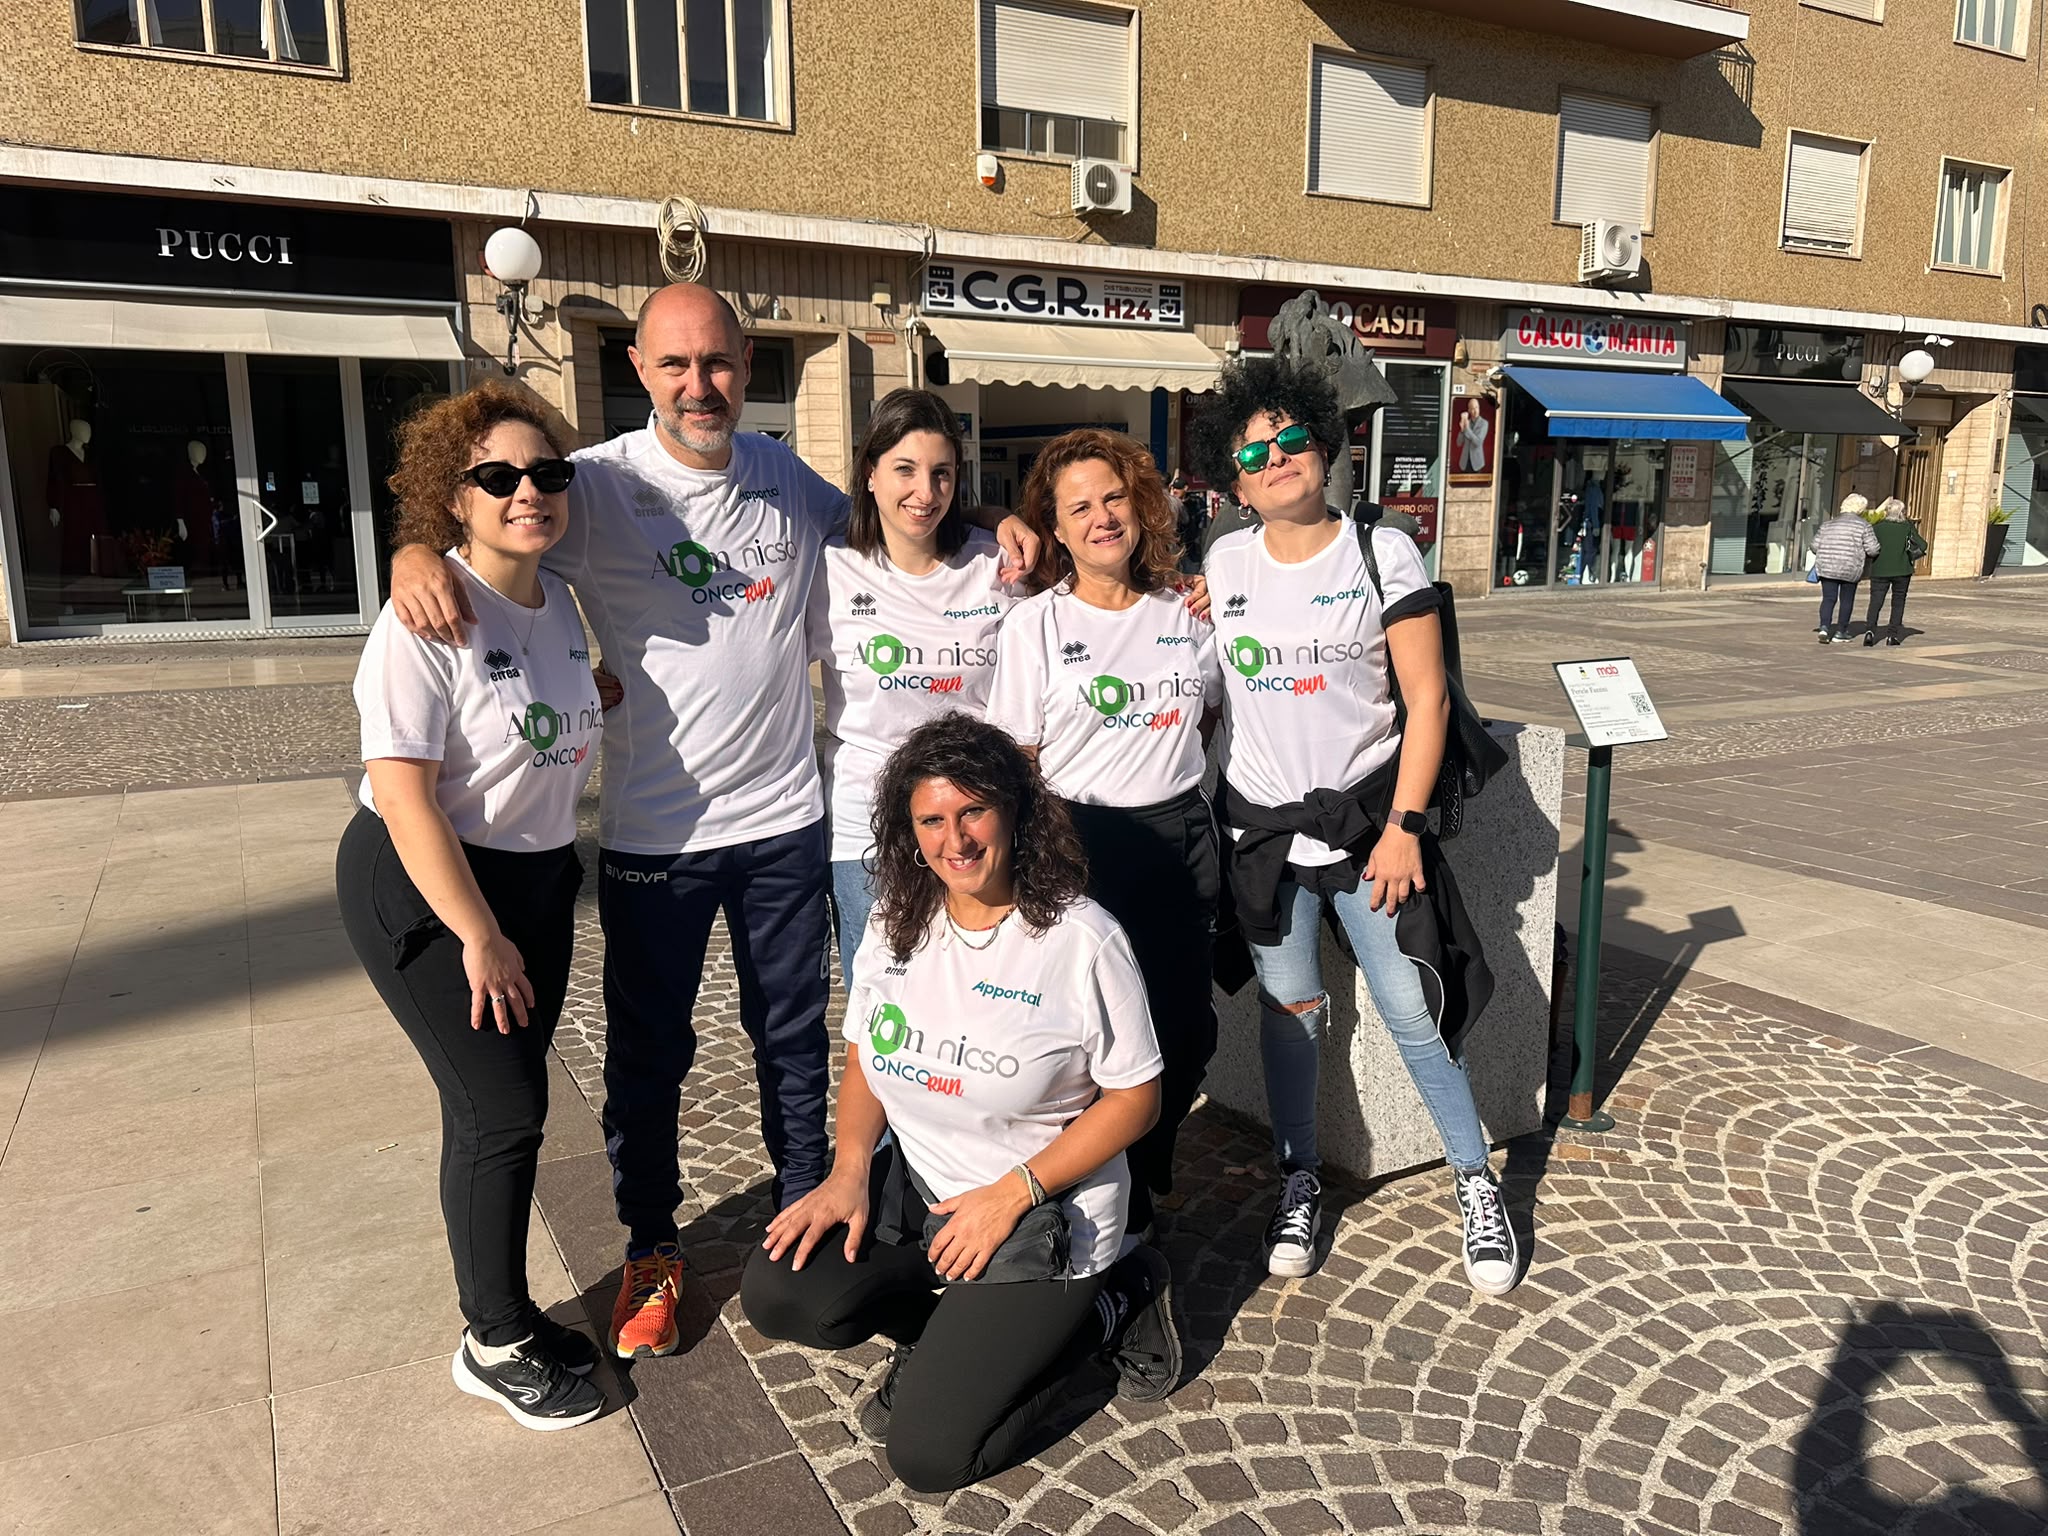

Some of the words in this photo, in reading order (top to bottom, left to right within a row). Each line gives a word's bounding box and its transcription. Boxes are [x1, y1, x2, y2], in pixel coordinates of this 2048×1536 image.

[155, 228, 293, 265] PUCCI
[961, 270, 1099, 317] C.G.R.
[1104, 297, 1152, 321] H24
[1776, 344, 1819, 362] PUCCI
[635, 505, 664, 518] errea
[742, 539, 798, 568] nicso
[852, 607, 877, 616] errea
[943, 603, 1000, 619] Apportal
[1223, 609, 1245, 618] errea
[938, 642, 997, 667] nicso
[1063, 653, 1091, 665] errea
[1296, 639, 1364, 665] nicso
[490, 667, 521, 681] errea
[580, 701, 604, 731] nic
[606, 864, 668, 884] GIVOVA
[972, 981, 1042, 1007] Apportal
[937, 1035, 1020, 1079] nicso
